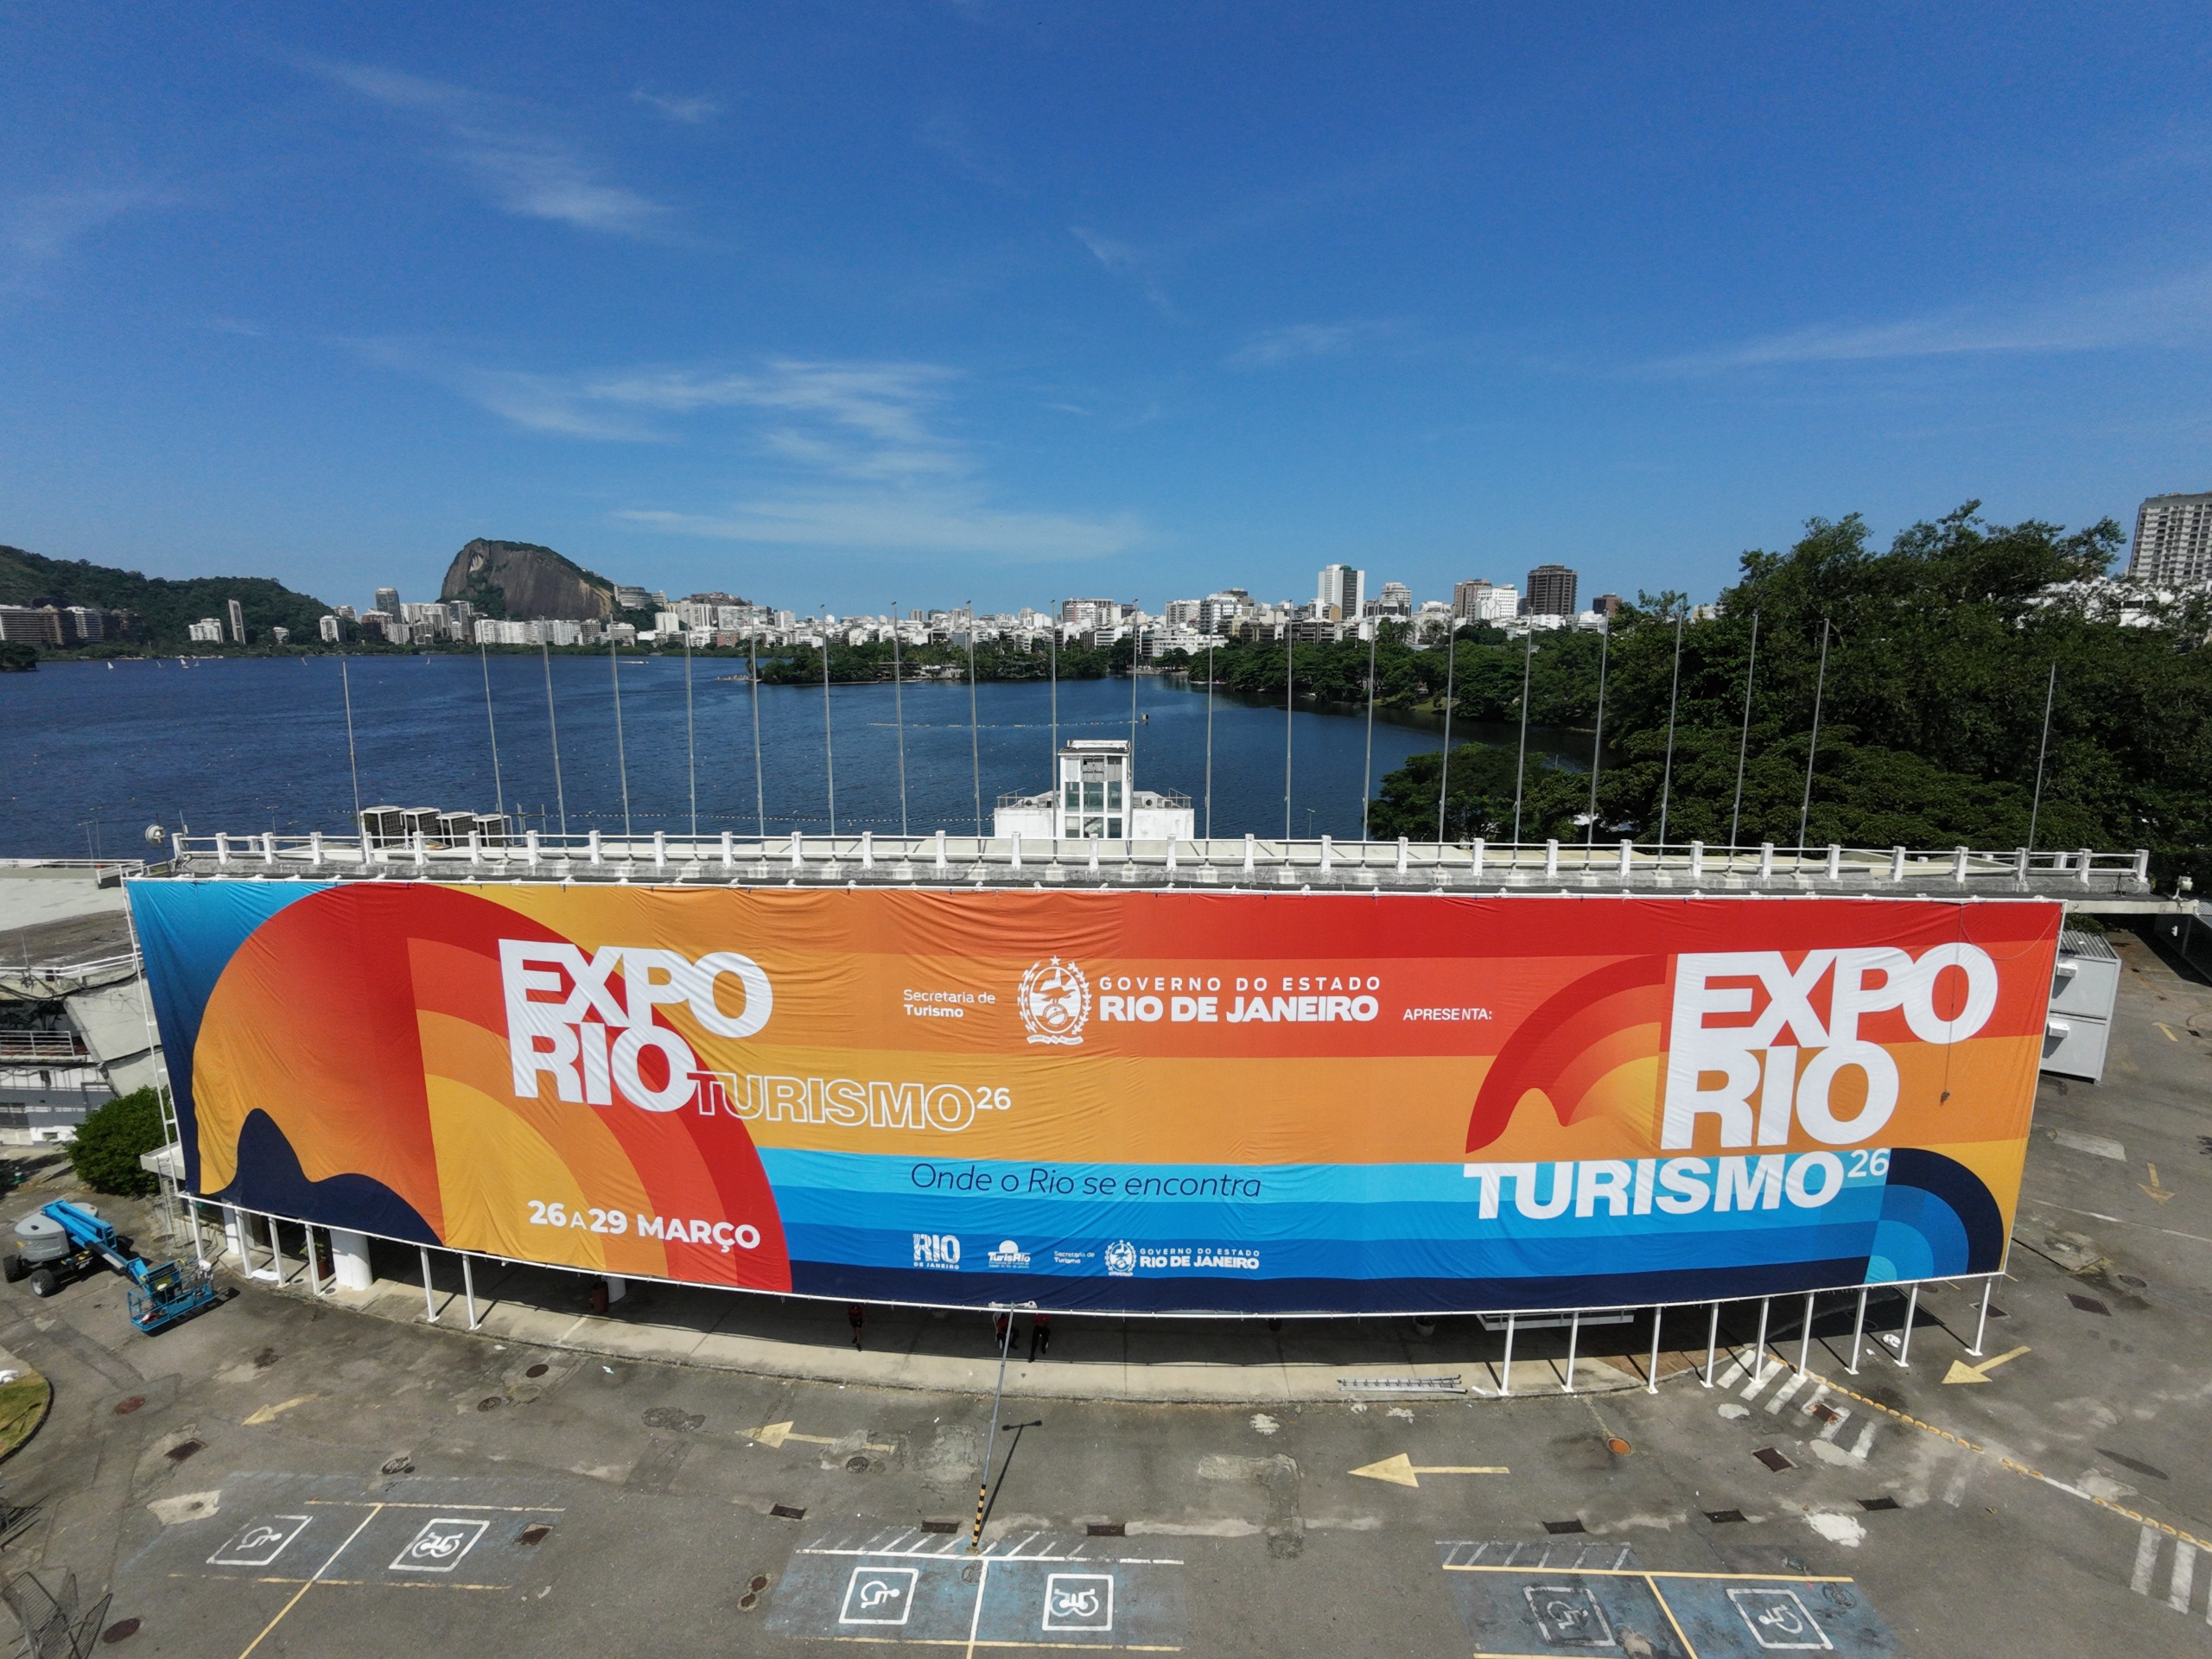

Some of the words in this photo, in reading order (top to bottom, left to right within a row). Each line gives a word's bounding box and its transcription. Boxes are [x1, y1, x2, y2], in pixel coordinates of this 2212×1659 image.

[499, 938, 773, 1038] EXPO
[903, 989, 975, 1004] Secretaria
[977, 991, 996, 1004] de
[1099, 976, 1222, 992] GOVERNO
[1236, 976, 1268, 992] DO
[1281, 976, 1381, 992] ESTADO
[1669, 942, 1999, 1047] EXPO
[903, 1003, 964, 1018] Turismo
[1099, 995, 1164, 1022] RIO
[1170, 995, 1218, 1022] DE
[1225, 995, 1380, 1023] JANEIRO
[1402, 1007, 1493, 1021] APRESENTA:
[507, 1021, 698, 1113] RIO
[687, 1071, 975, 1132] TURISMO
[976, 1086, 1011, 1109] 26
[1660, 1039, 1900, 1150] RIO
[911, 1163, 993, 1192] Onde
[1001, 1173, 1020, 1192] o
[1027, 1167, 1075, 1195] Rio
[1082, 1176, 1116, 1196] se
[1124, 1173, 1262, 1198] encontra
[1463, 1150, 1845, 1220] TURISMO
[1847, 1147, 1890, 1179] 26
[527, 1199, 567, 1227] 26
[570, 1211, 588, 1230] A
[588, 1208, 628, 1235] 29
[637, 1214, 761, 1254] MARÇO
[912, 1233, 961, 1264] RIO
[988, 1251, 1031, 1262] TurisRio
[1140, 1255, 1168, 1268] RIO
[1170, 1255, 1191, 1268] DE
[1193, 1255, 1261, 1269] JANEIRO
[1217, 1248, 1261, 1257] ESTADO
